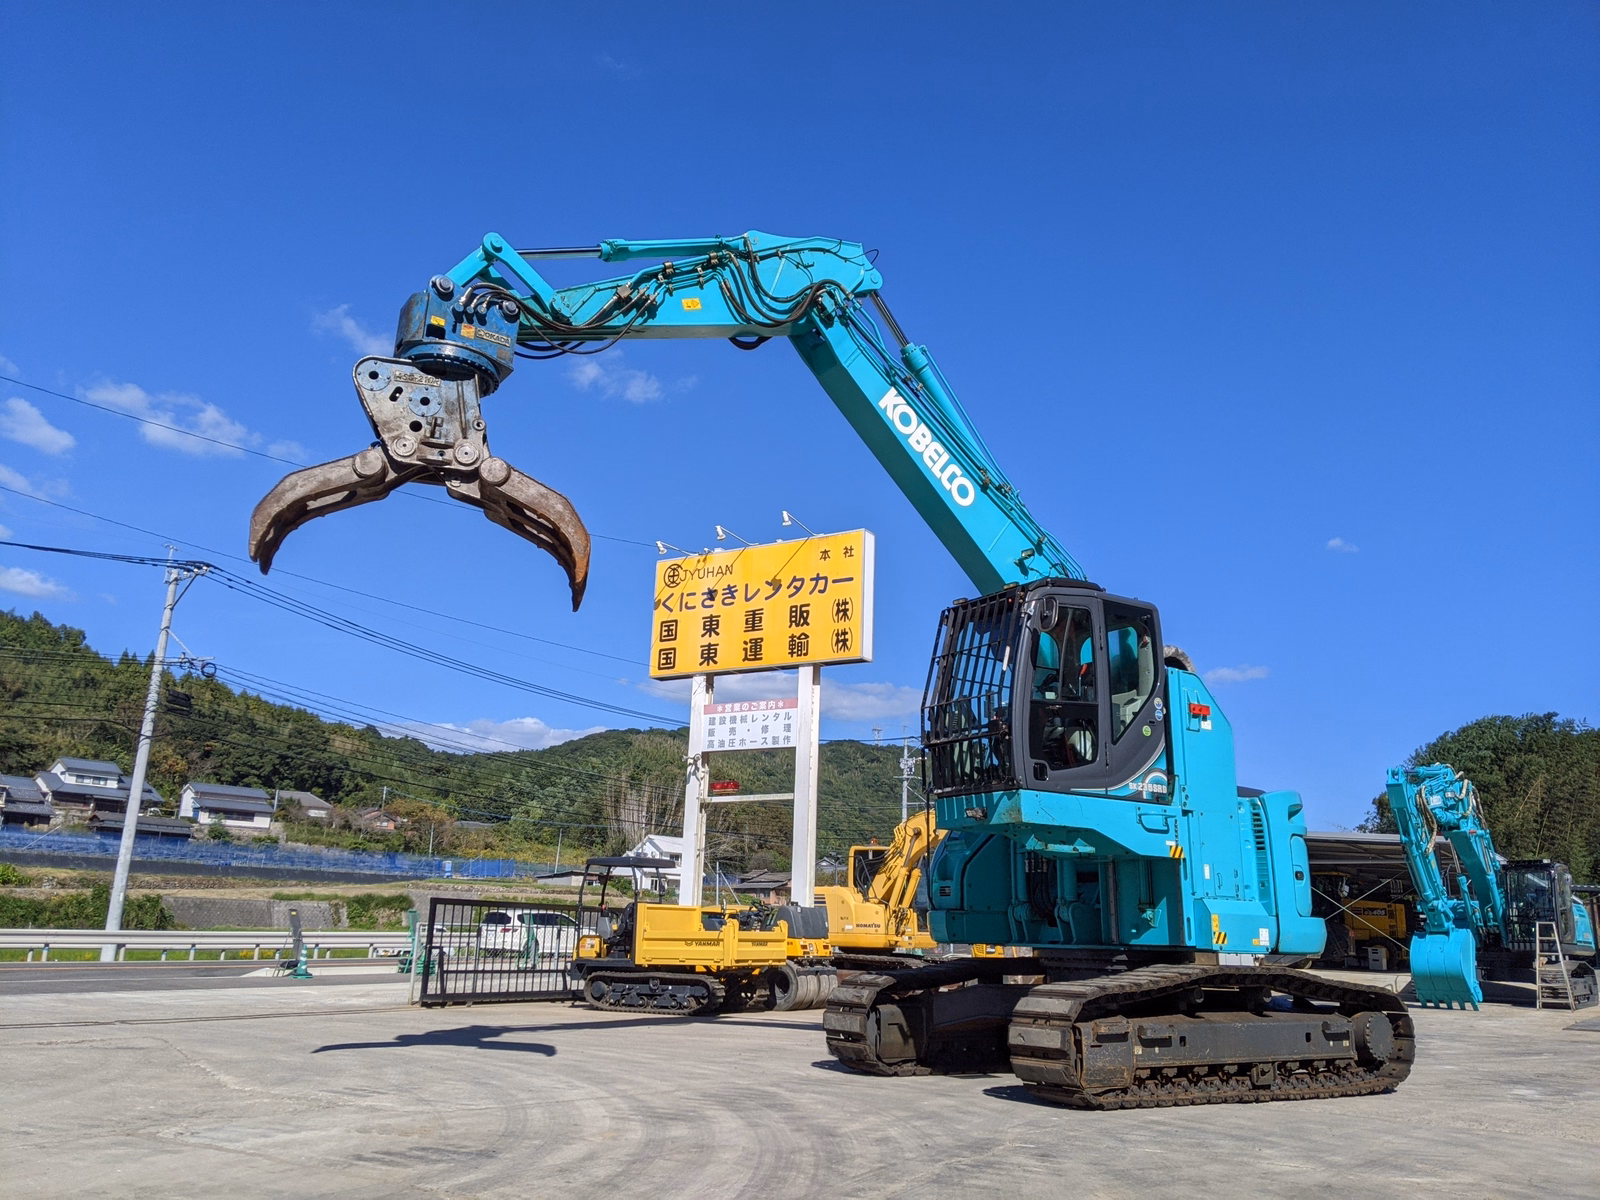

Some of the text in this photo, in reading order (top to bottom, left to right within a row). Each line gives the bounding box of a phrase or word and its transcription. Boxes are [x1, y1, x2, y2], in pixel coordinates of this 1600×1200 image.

[878, 386, 975, 507] KOBELCO
[819, 545, 855, 562] 本社
[680, 564, 733, 582] JYUHAN
[660, 572, 854, 613] くにさきレンタカー
[708, 712, 792, 726] 建設機械レンタル
[706, 735, 791, 749] 高油圧ホース製作
